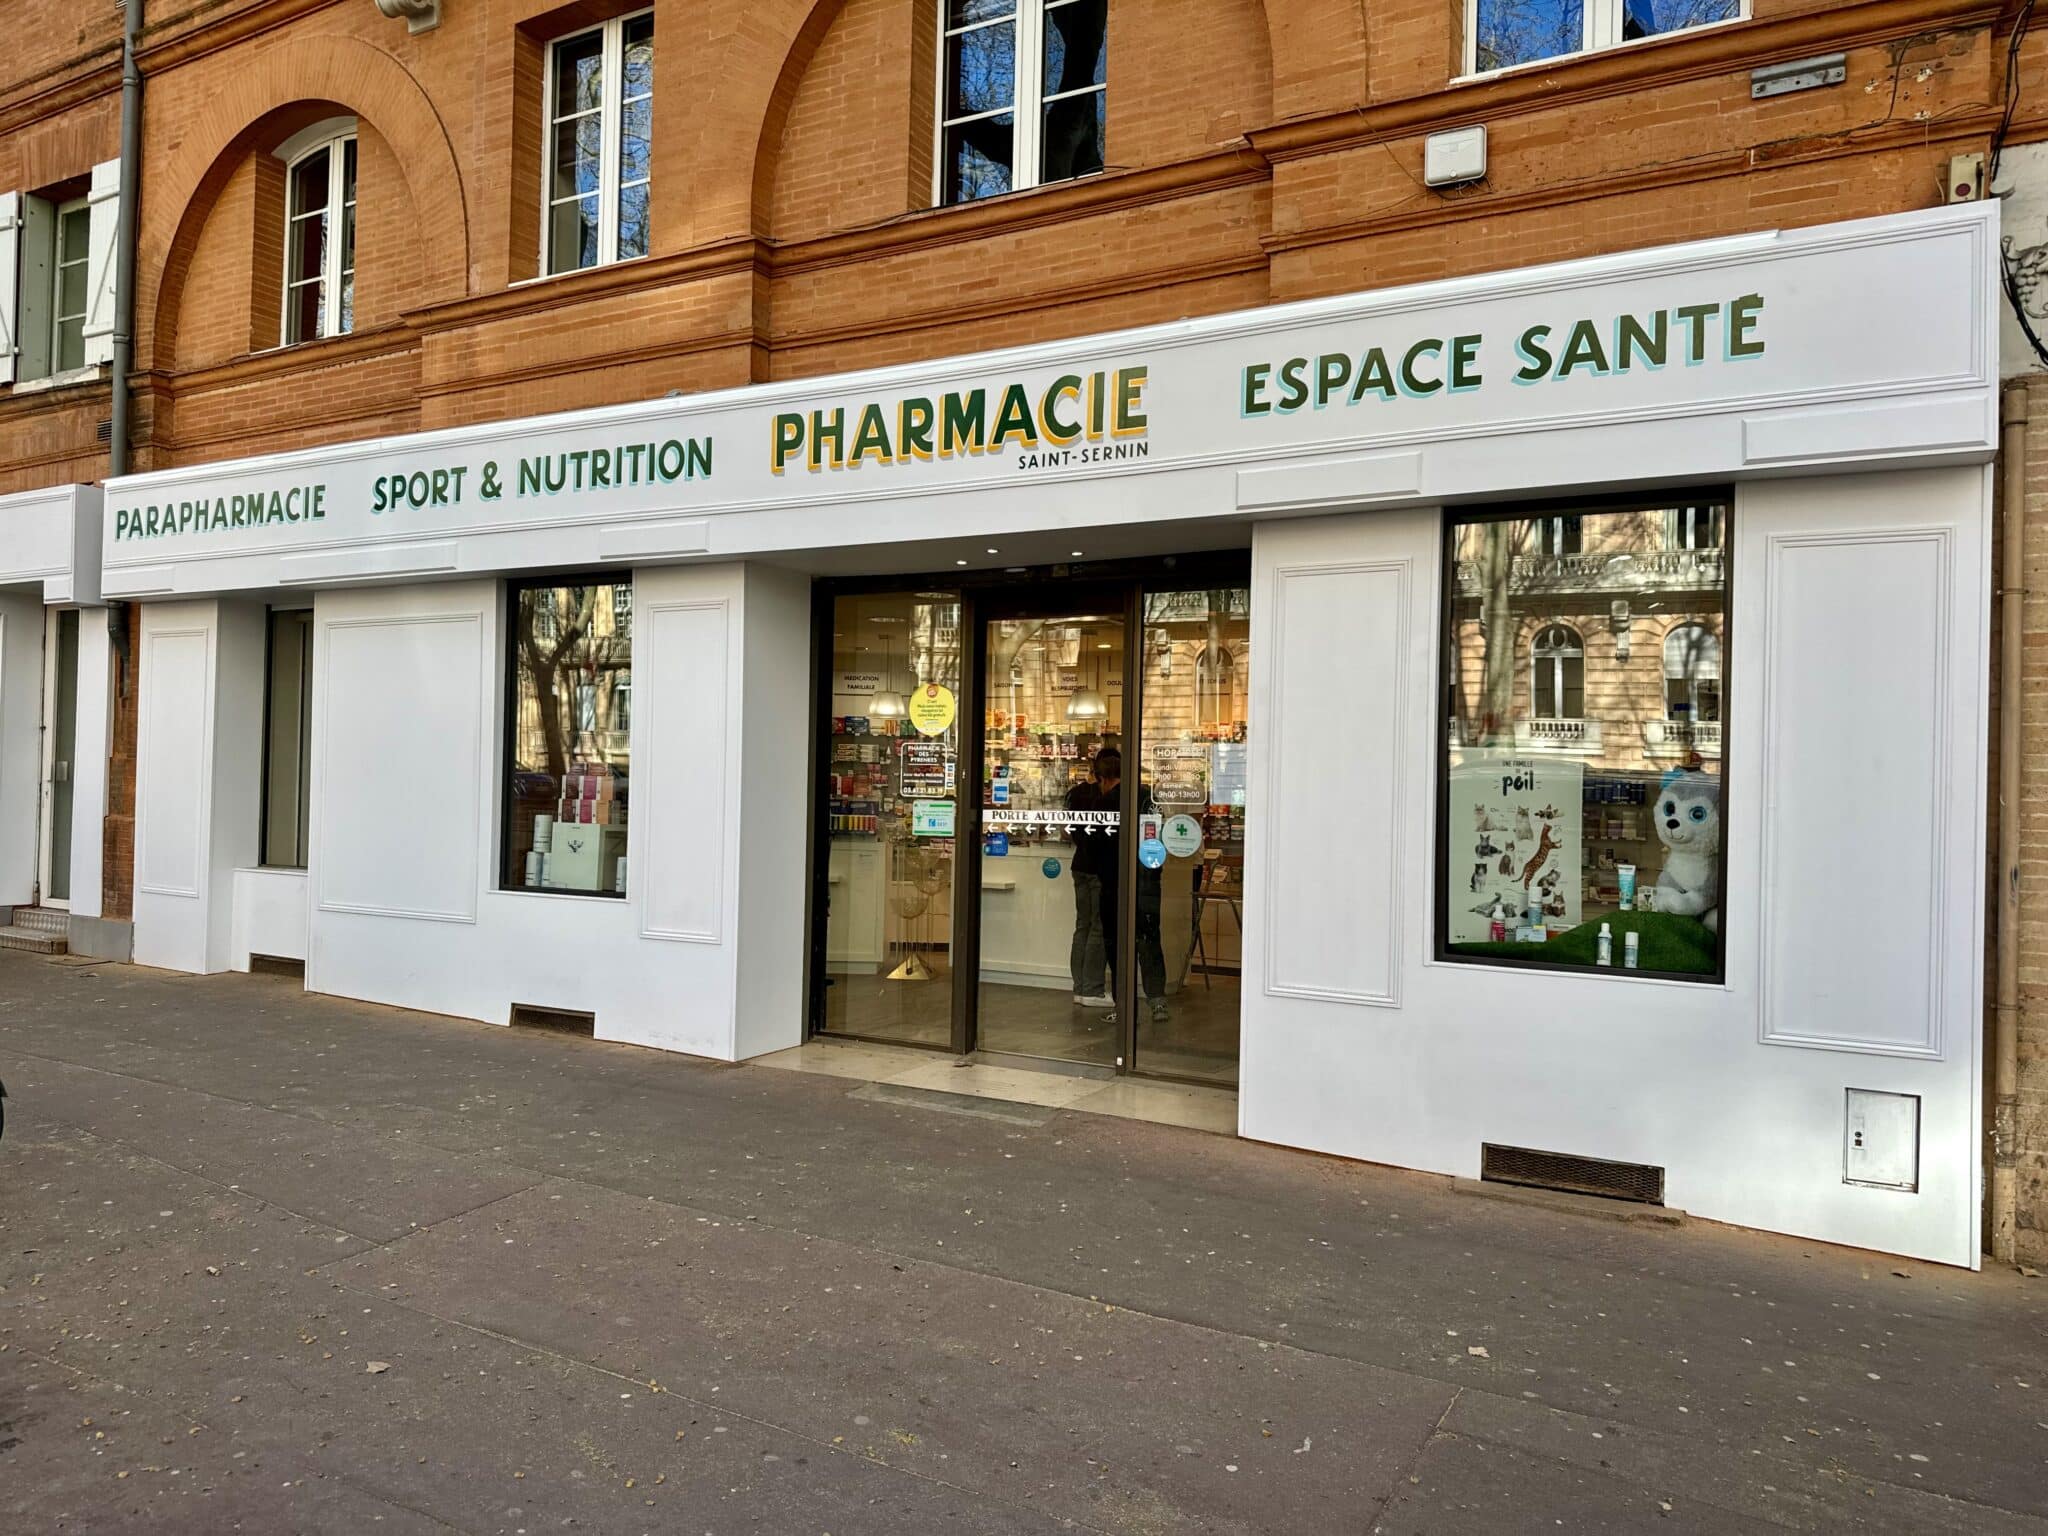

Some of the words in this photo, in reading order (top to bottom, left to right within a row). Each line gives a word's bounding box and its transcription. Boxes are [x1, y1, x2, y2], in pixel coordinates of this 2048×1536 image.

[1240, 333, 1483, 419] ESPACE
[770, 365, 1149, 475] PHARMACIE
[371, 465, 468, 513] SPORT
[480, 460, 503, 499] &
[518, 435, 713, 497] NUTRITION
[1018, 441, 1149, 470] SAINT-SERNIN
[114, 484, 326, 541] PARAPHARMACIE
[1502, 769, 1534, 797] poil
[991, 810, 1029, 821] PORTE
[1034, 810, 1120, 825] AUTOMATIQUE
